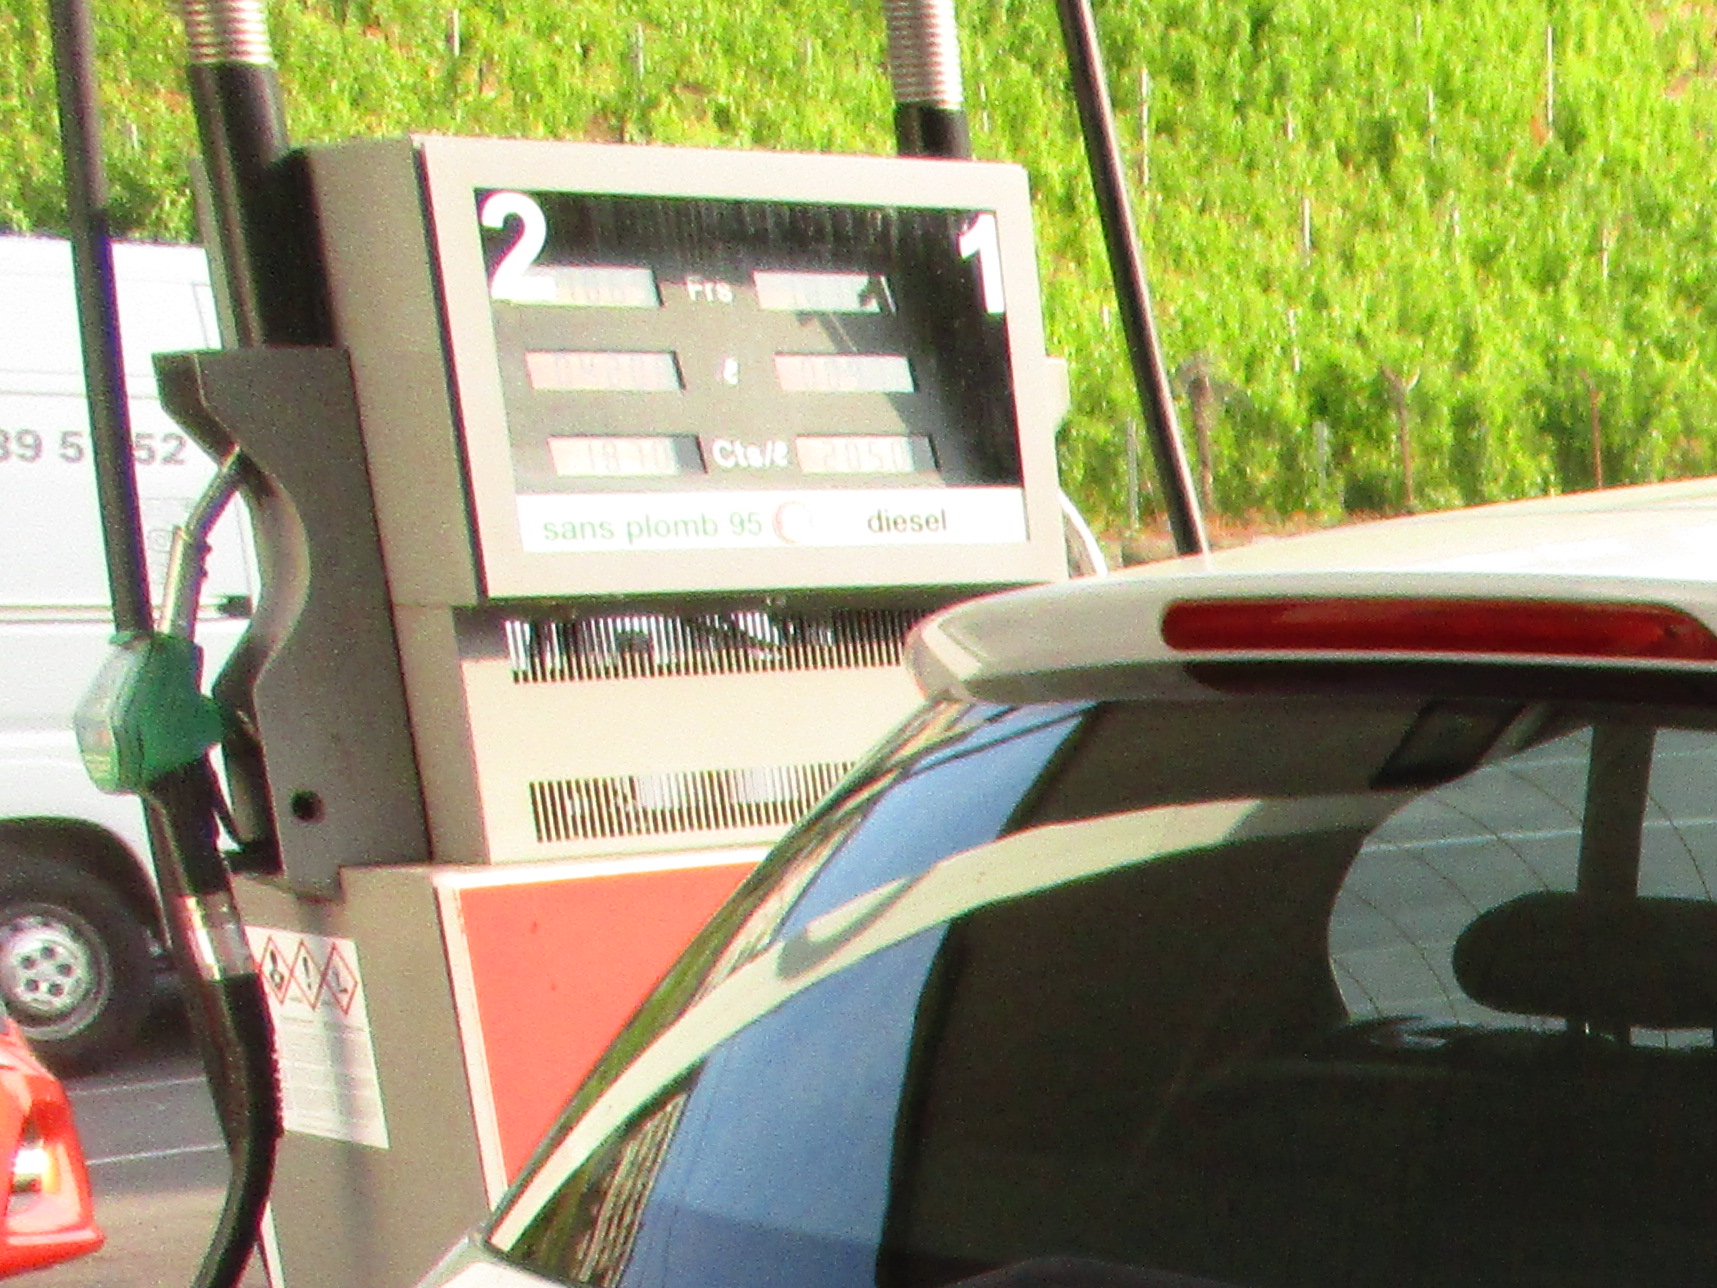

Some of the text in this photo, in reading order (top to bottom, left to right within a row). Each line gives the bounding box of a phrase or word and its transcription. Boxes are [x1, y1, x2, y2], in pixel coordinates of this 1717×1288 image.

[480, 191, 557, 301] 2
[958, 210, 1005, 314] 1
[543, 510, 763, 545] sans plomb 95
[866, 507, 947, 534] diesel
